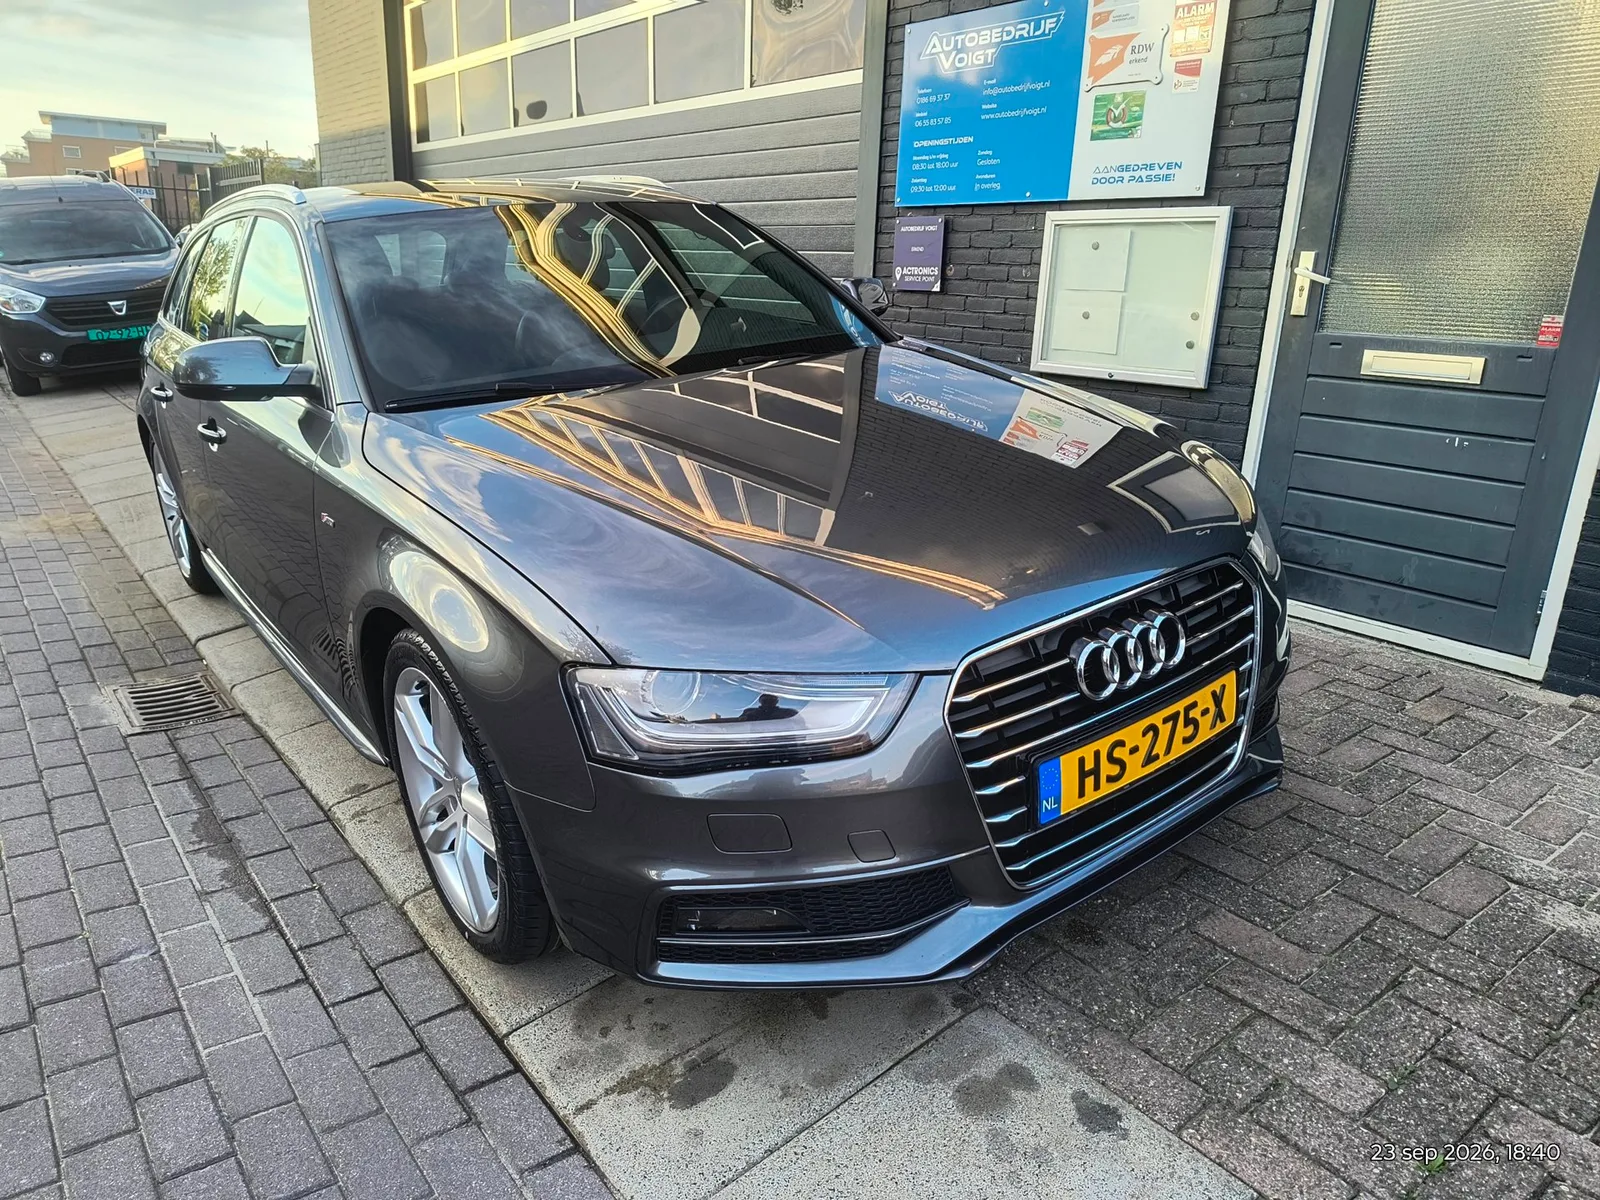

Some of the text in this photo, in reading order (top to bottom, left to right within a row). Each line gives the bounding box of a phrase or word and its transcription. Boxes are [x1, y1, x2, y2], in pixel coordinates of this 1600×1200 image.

[1176, 2, 1214, 20] ALARM
[925, 18, 1058, 54] AUTOBEDRIJF
[1130, 43, 1155, 55] RDW
[940, 48, 997, 70] VOIGT
[1128, 56, 1148, 65] erkend
[913, 136, 974, 148] OPENINGSTIJDEN
[927, 161, 935, 169] tot
[976, 158, 1001, 166] Gesloten
[1092, 161, 1183, 174] AANGEDREVEN
[1091, 173, 1176, 185] DOOR PASSIE!
[925, 184, 933, 192] tot
[980, 182, 1001, 192] overleg
[902, 267, 939, 275] ACTRONICS
[1077, 683, 1227, 799] HS-275-X
[1042, 796, 1058, 813] NL
